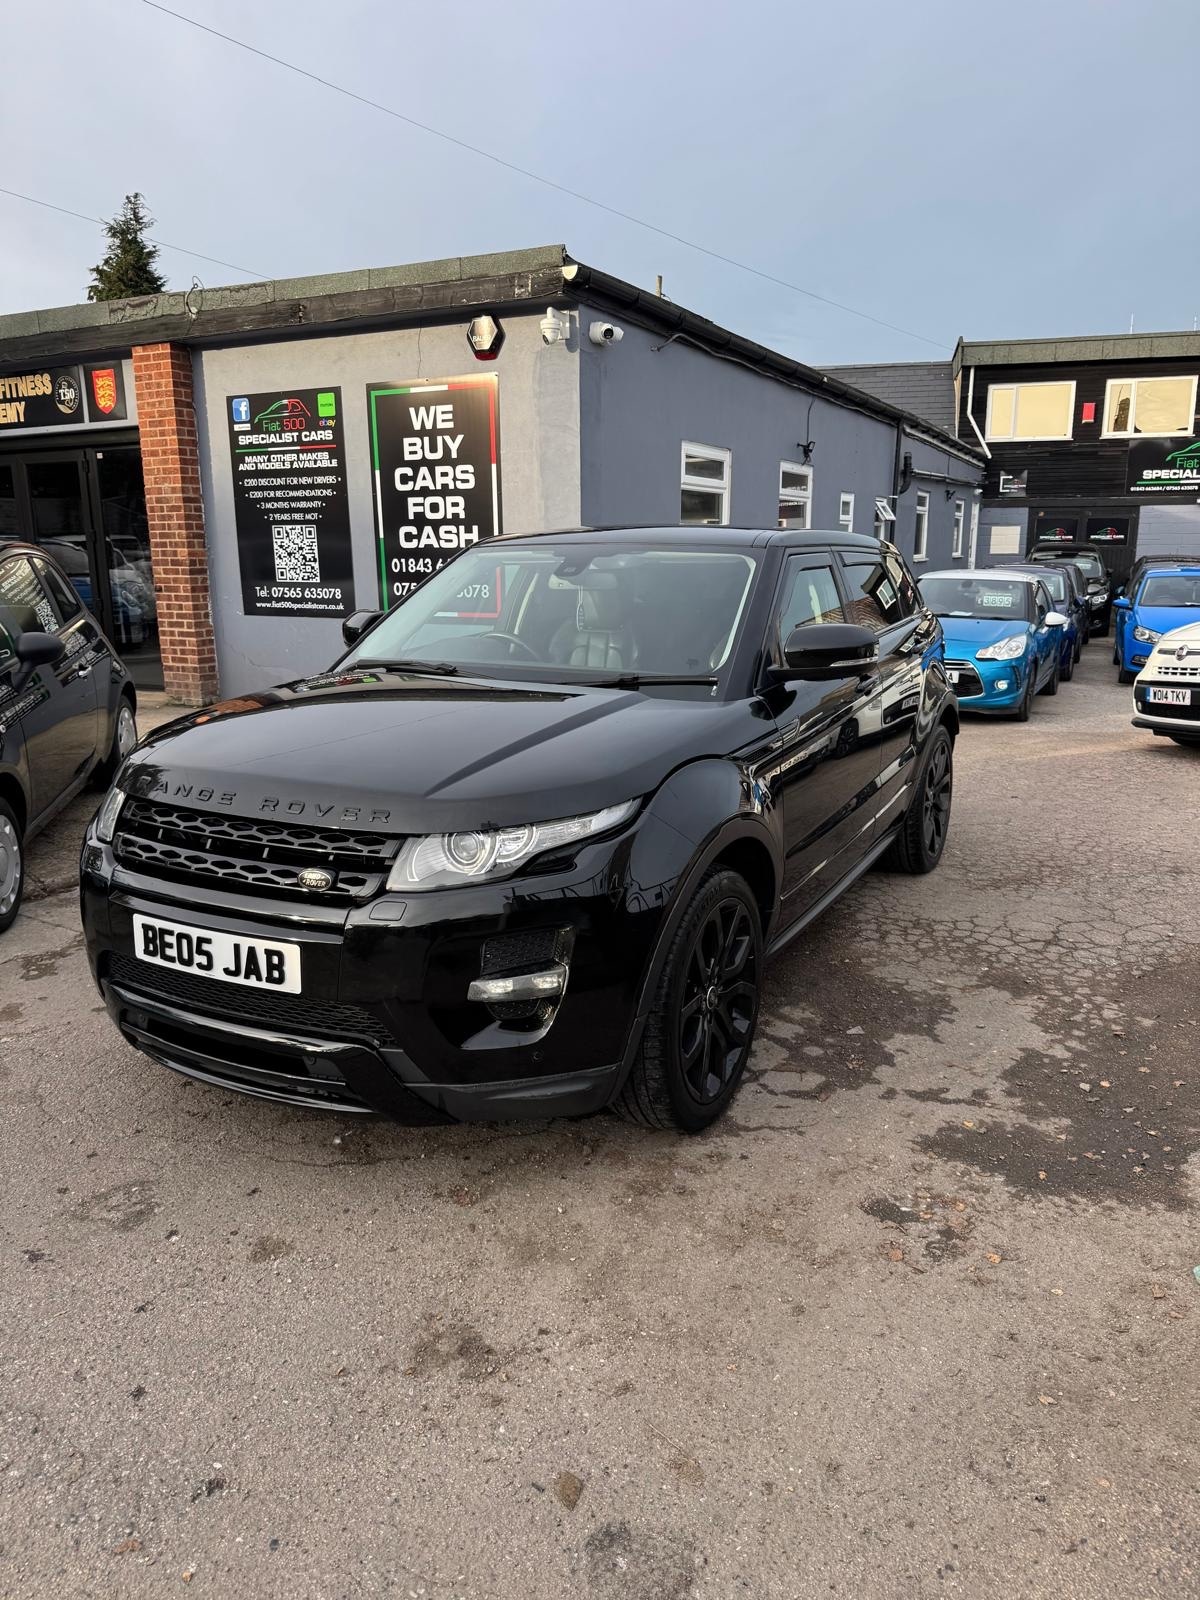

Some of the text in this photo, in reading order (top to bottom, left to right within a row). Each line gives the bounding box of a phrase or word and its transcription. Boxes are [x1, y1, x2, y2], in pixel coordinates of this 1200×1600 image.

[0, 373, 52, 399] FITNESS
[319, 419, 335, 427] ebay
[409, 405, 454, 430] WE
[263, 420, 280, 431] Fiat
[283, 418, 305, 430] 500
[239, 430, 333, 445] SPECIALIST CARS
[403, 435, 464, 460] BUY
[245, 452, 329, 463] MANY OTHER MAKES
[1177, 457, 1200, 468] Fiat
[239, 459, 338, 471] AND MODELS AVAILABLE
[394, 465, 475, 491] CARS
[1142, 469, 1200, 479] SPECIAL
[258, 478, 286, 486] DISCOUNT
[299, 476, 314, 484] NEW
[314, 476, 337, 484] DRIVERS
[276, 489, 333, 497] RECOMMENDATIONS
[408, 496, 466, 520] FOR
[399, 525, 479, 549] CASH
[392, 558, 432, 572] 01843
[255, 586, 342, 599] Tel: 07565 635078
[983, 596, 1012, 607] 3895
[1171, 690, 1186, 702] TKV
[136, 775, 391, 823] RANGE ROVER
[306, 879, 325, 887] ROVER
[141, 923, 285, 985] BE05 JAB
